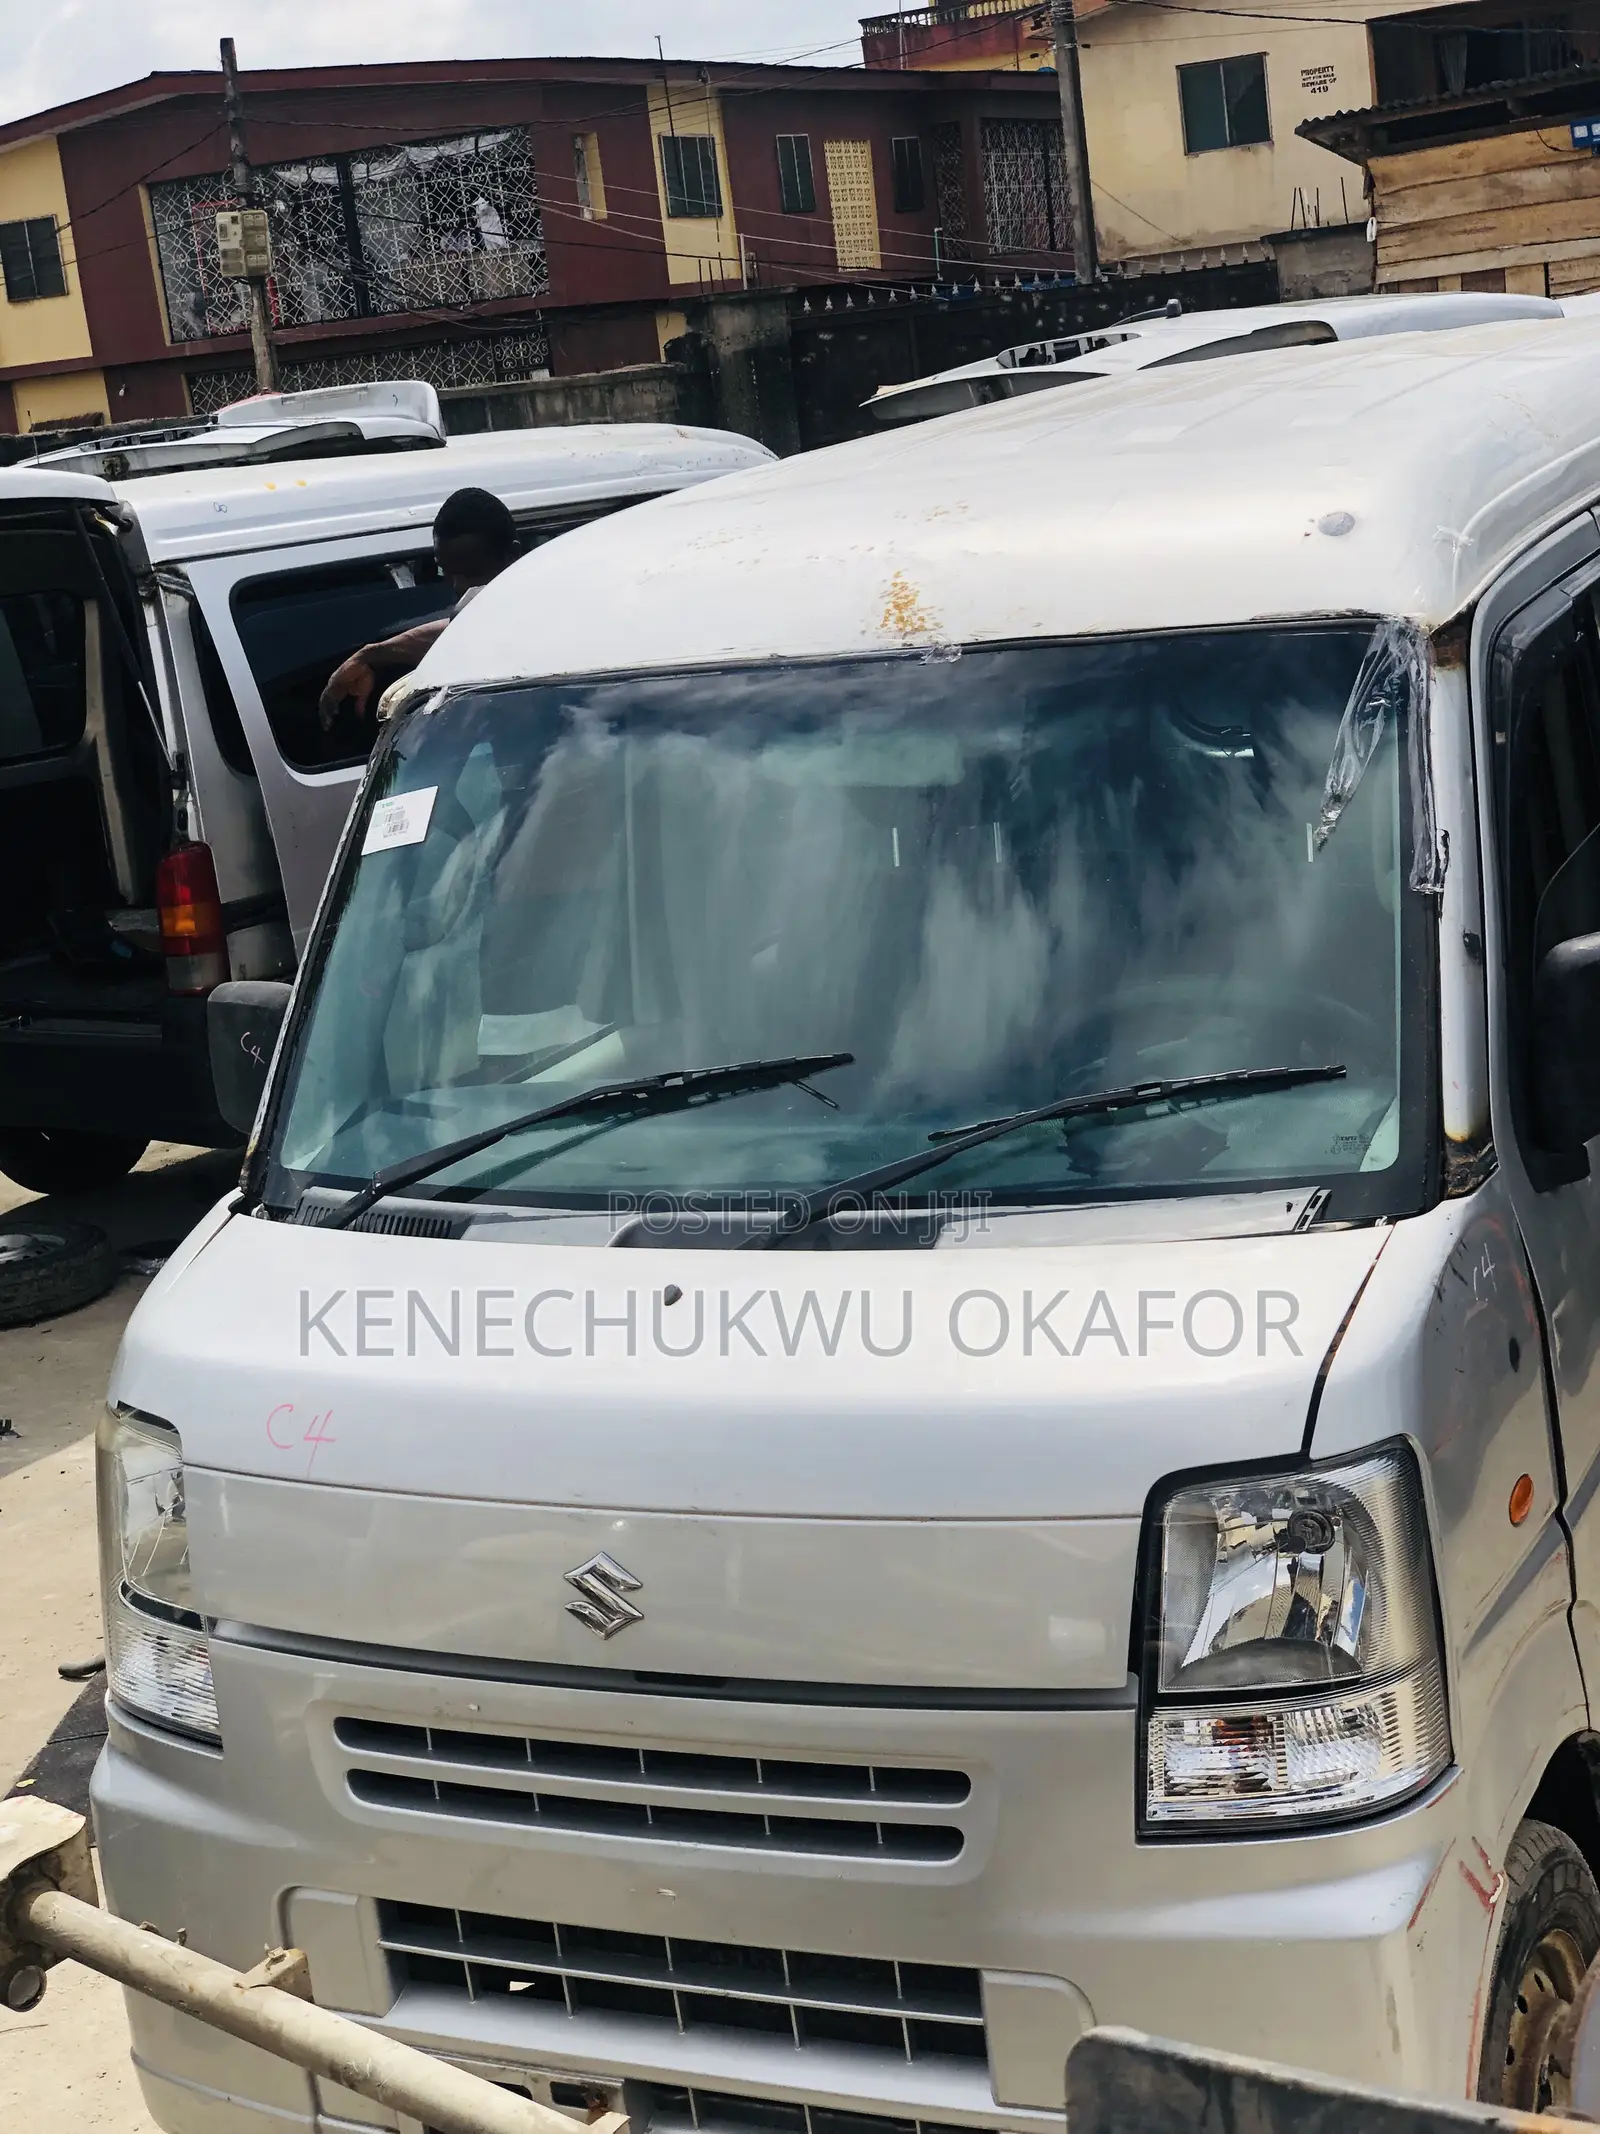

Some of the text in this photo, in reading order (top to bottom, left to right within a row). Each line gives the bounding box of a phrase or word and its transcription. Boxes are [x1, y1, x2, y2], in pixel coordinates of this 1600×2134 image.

[1300, 65, 1335, 76] PROPERTY
[1302, 79, 1327, 88] BEWARE
[1310, 85, 1329, 94] 419
[266, 1403, 337, 1478] C4
